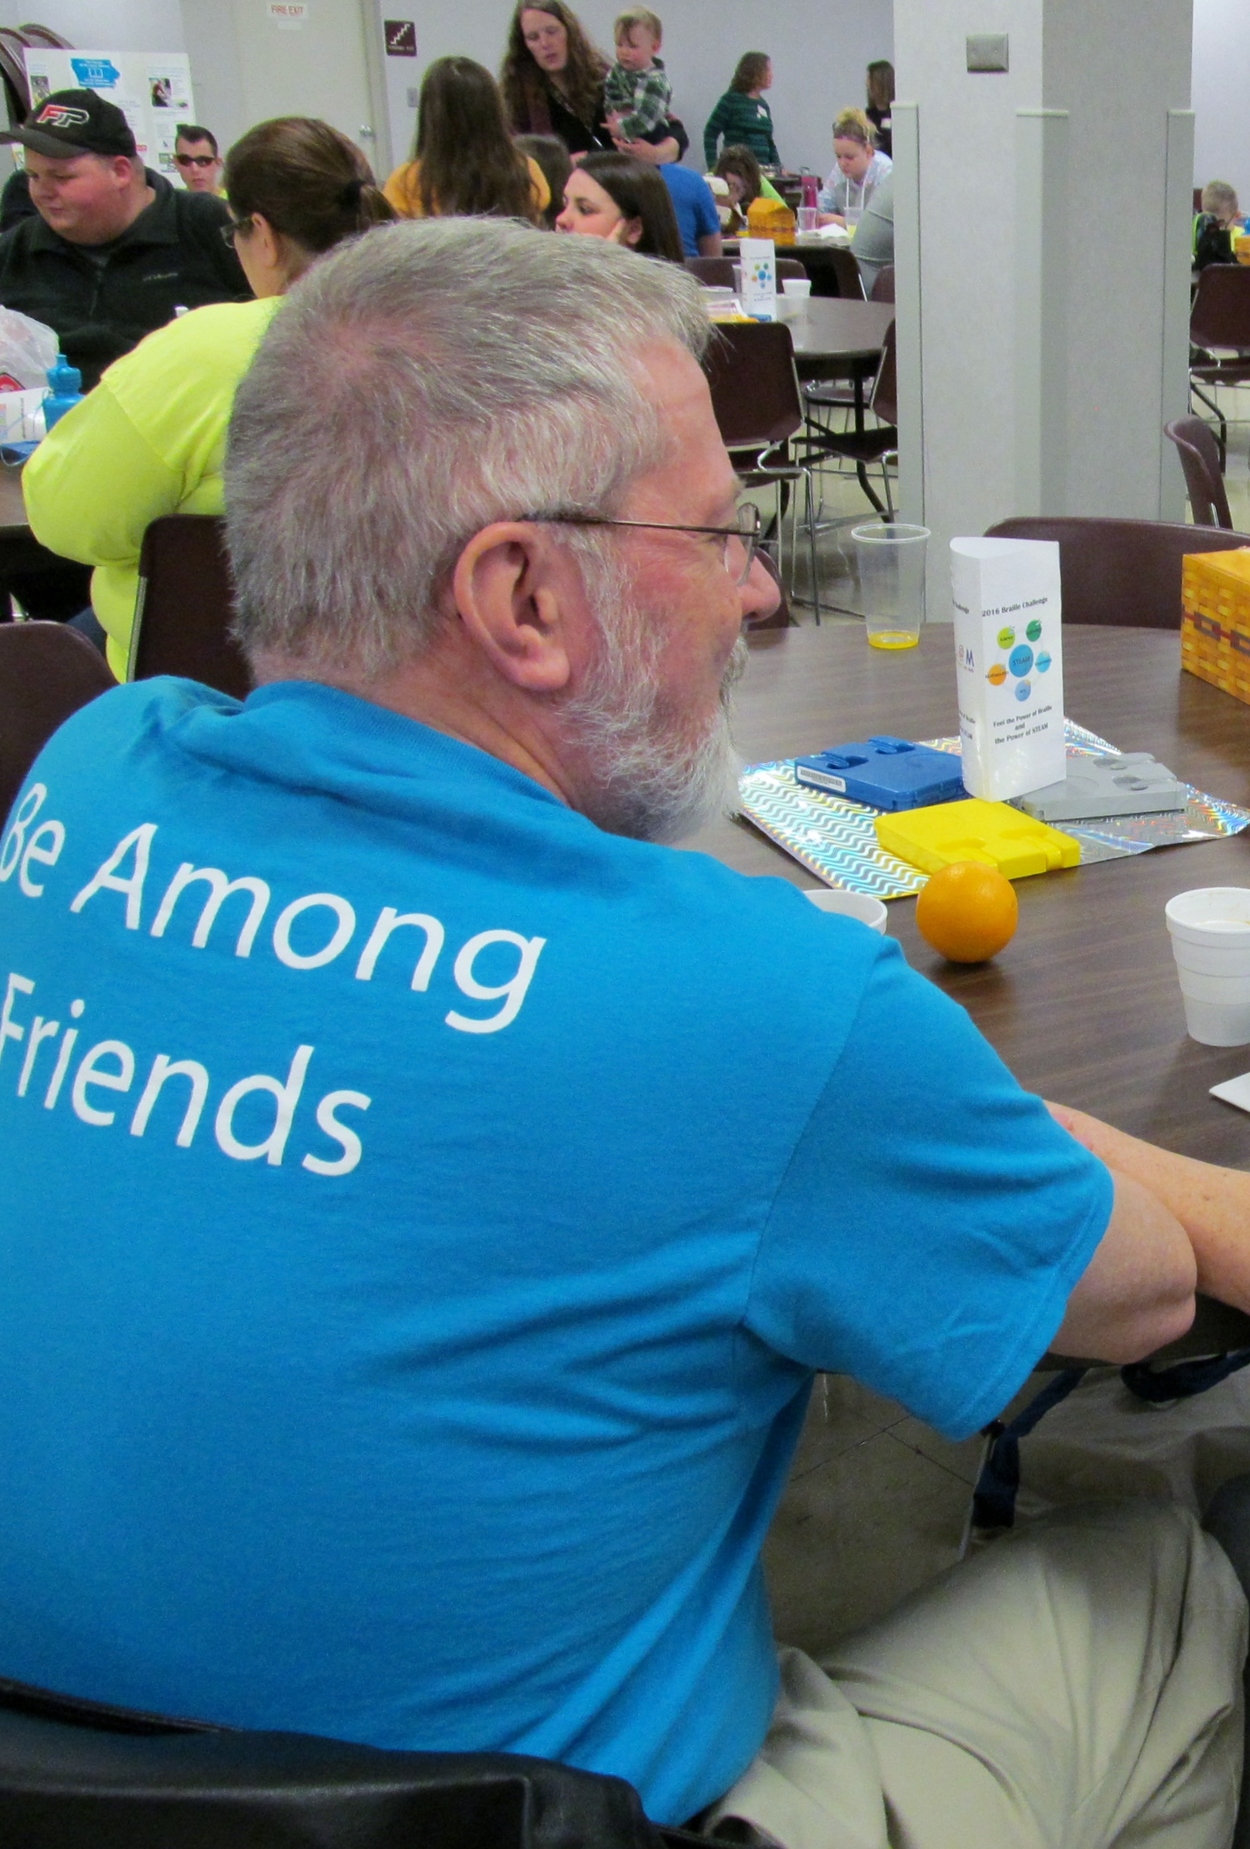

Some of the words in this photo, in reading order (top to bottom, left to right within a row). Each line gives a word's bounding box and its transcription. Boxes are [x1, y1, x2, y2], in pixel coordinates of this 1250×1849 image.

[271, 4, 288, 15] FIRE
[288, 5, 304, 17] EXIT
[982, 607, 1000, 617] 2016
[1001, 603, 1021, 614] Braille
[1022, 597, 1047, 608] Challenge
[993, 719, 1005, 728] Feel
[1016, 712, 1031, 721] Power
[1038, 705, 1052, 714] Braille
[1014, 722, 1026, 731] and
[994, 737, 1005, 745] the
[1006, 732, 1025, 742] Power
[1032, 722, 1048, 734] STEAM
[0, 783, 66, 898] Be
[70, 822, 547, 1034] Among
[0, 972, 372, 1176] Friends
